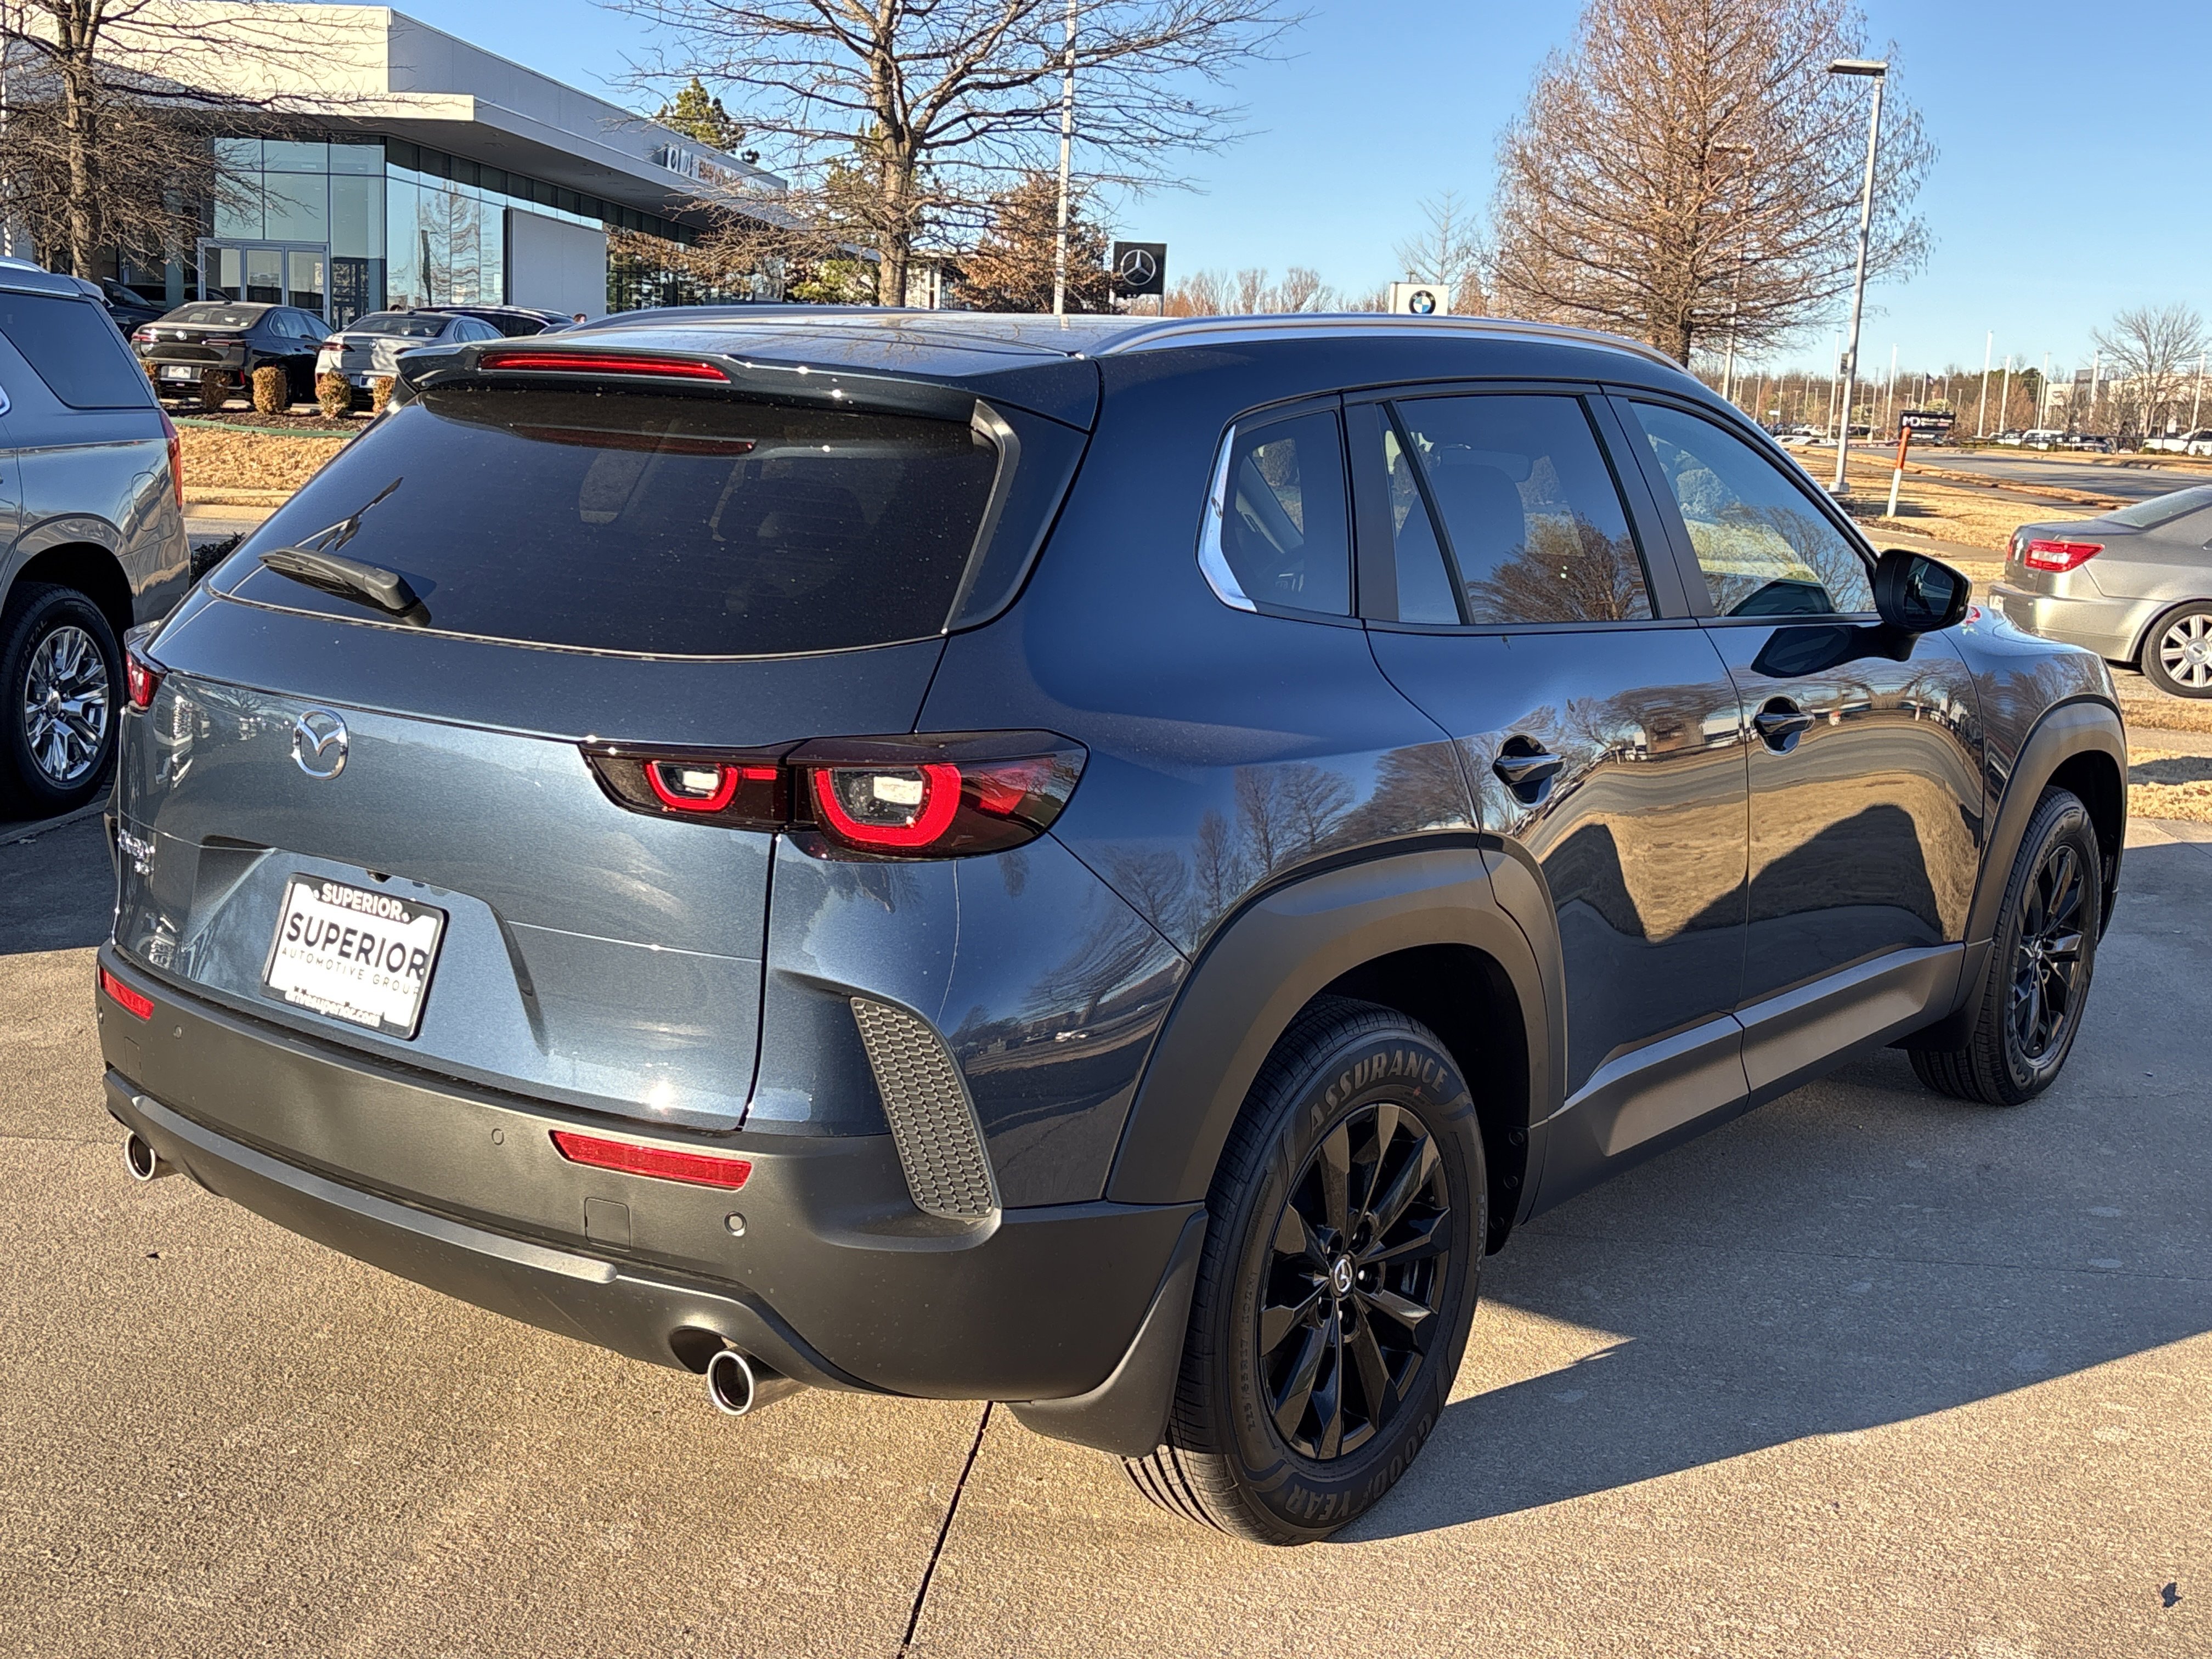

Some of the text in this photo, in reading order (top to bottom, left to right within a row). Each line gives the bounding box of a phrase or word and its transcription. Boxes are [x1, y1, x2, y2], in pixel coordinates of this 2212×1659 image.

[321, 883, 403, 921] SUPERIOR
[286, 911, 429, 980] SUPERIOR
[281, 947, 419, 996] AUTOMOTIVE GROUP
[285, 988, 381, 1028] drivesuperior.com
[1310, 1049, 1448, 1136] ASSURANCE
